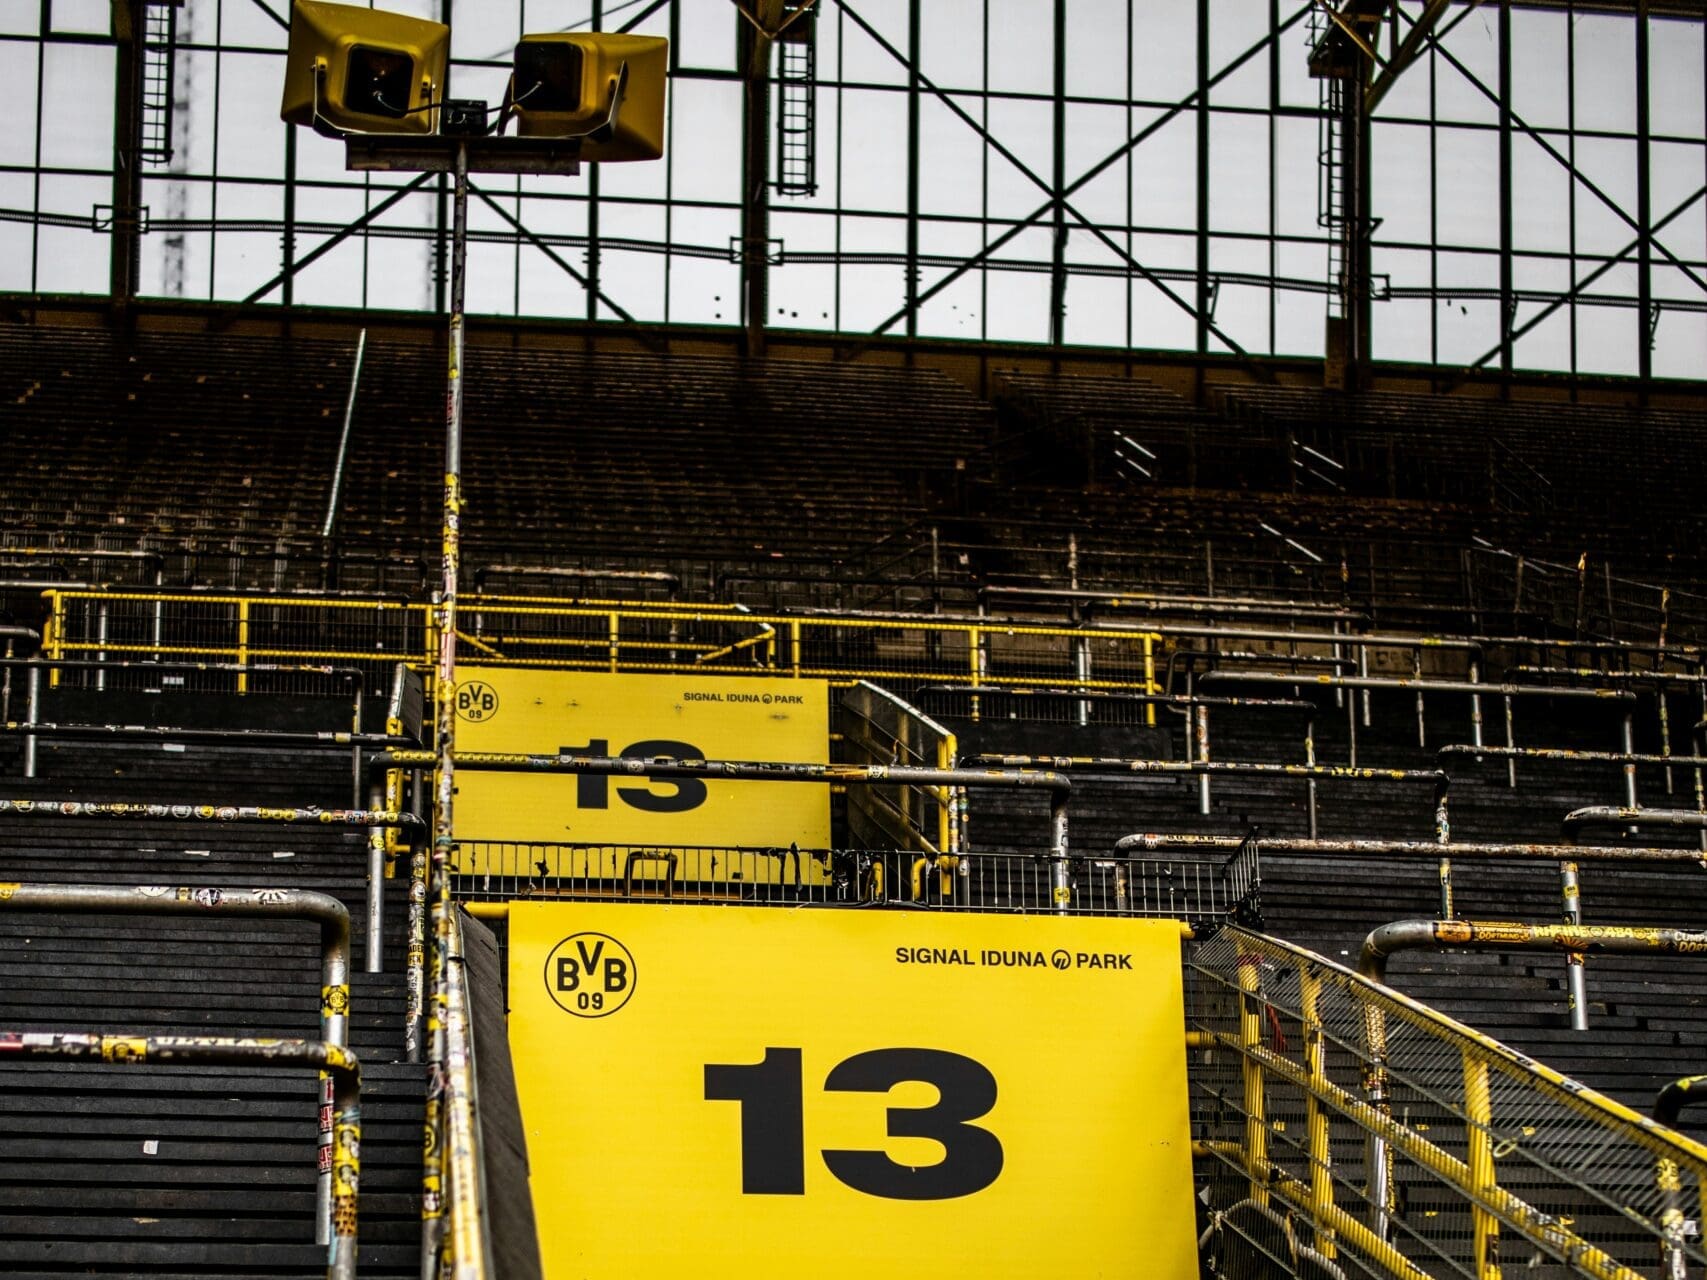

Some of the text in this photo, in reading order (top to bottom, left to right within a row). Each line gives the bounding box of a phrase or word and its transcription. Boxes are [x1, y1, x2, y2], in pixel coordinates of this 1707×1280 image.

[458, 684, 493, 710] BVB
[683, 692, 804, 704] SIGNAL IDUNA PARK
[468, 710, 482, 719] 09
[559, 738, 708, 812] 13
[557, 940, 627, 992] BVB
[896, 947, 1133, 970] SIGNAL IDUNA PARK
[577, 992, 604, 1010] 09
[704, 1047, 1005, 1200] 13
